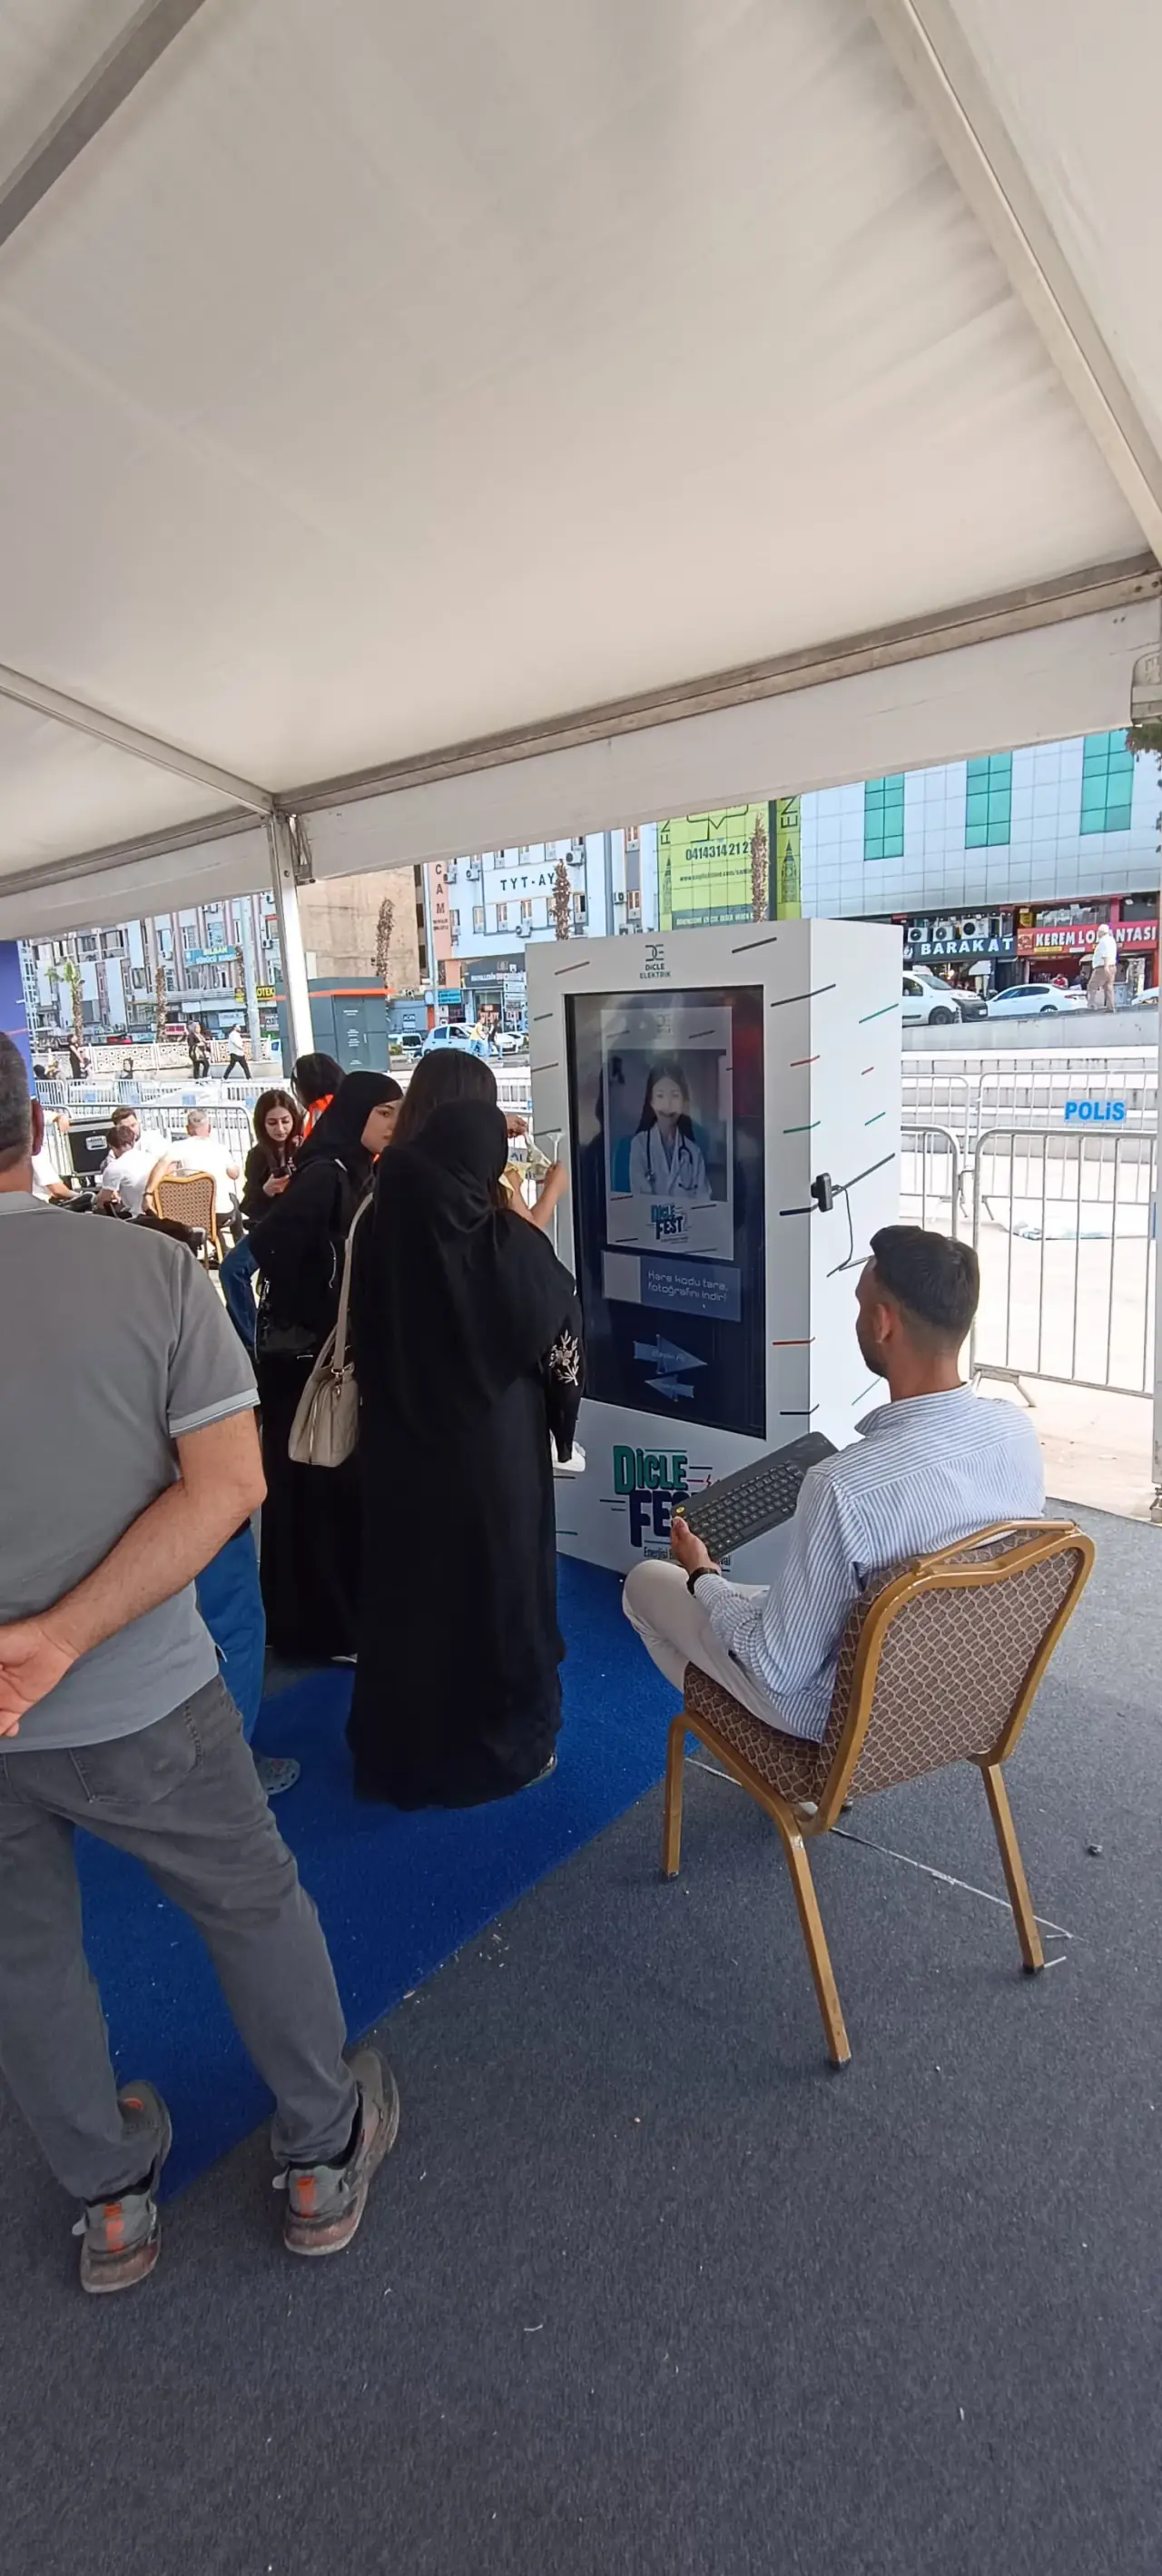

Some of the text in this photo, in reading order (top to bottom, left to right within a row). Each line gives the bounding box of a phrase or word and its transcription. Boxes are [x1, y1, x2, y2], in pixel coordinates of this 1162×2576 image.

[1036, 930, 1076, 946] KEREM
[1078, 926, 1157, 945] LOANTASI
[921, 938, 1013, 956] BARAKAT
[655, 1216, 684, 1240] FEST
[675, 1275, 700, 1286] kodu
